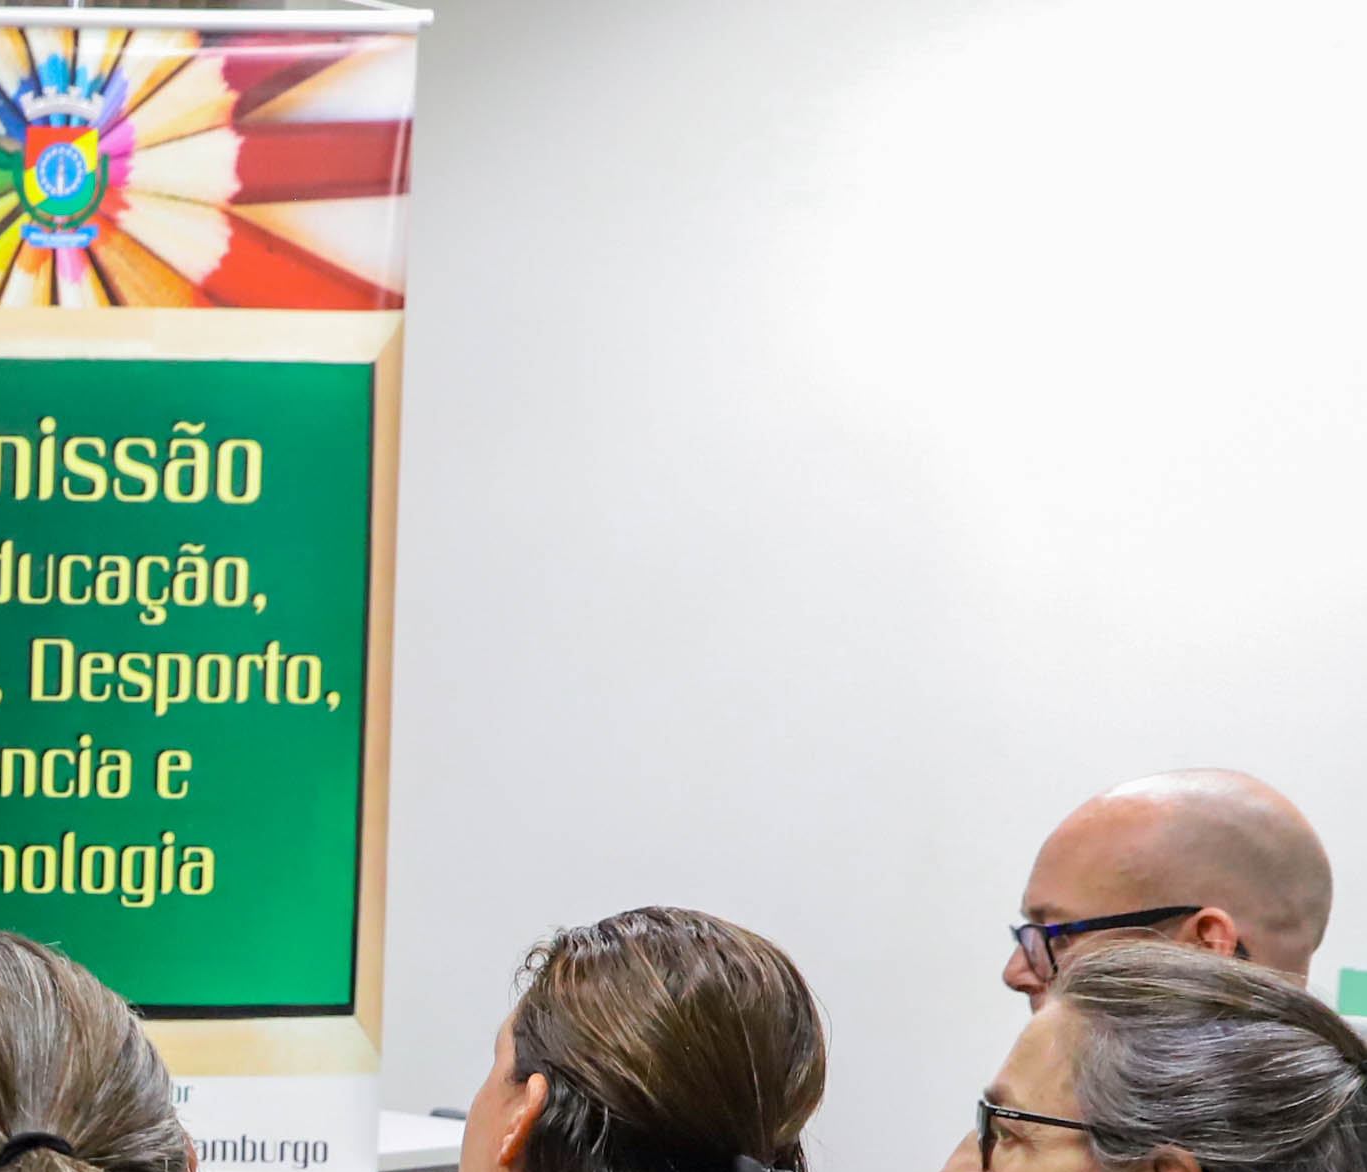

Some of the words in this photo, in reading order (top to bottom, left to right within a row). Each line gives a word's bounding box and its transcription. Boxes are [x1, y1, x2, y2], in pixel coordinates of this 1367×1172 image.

[29, 638, 342, 717] Desporto,
[155, 748, 194, 800] e
[192, 1134, 329, 1169] amburgo
